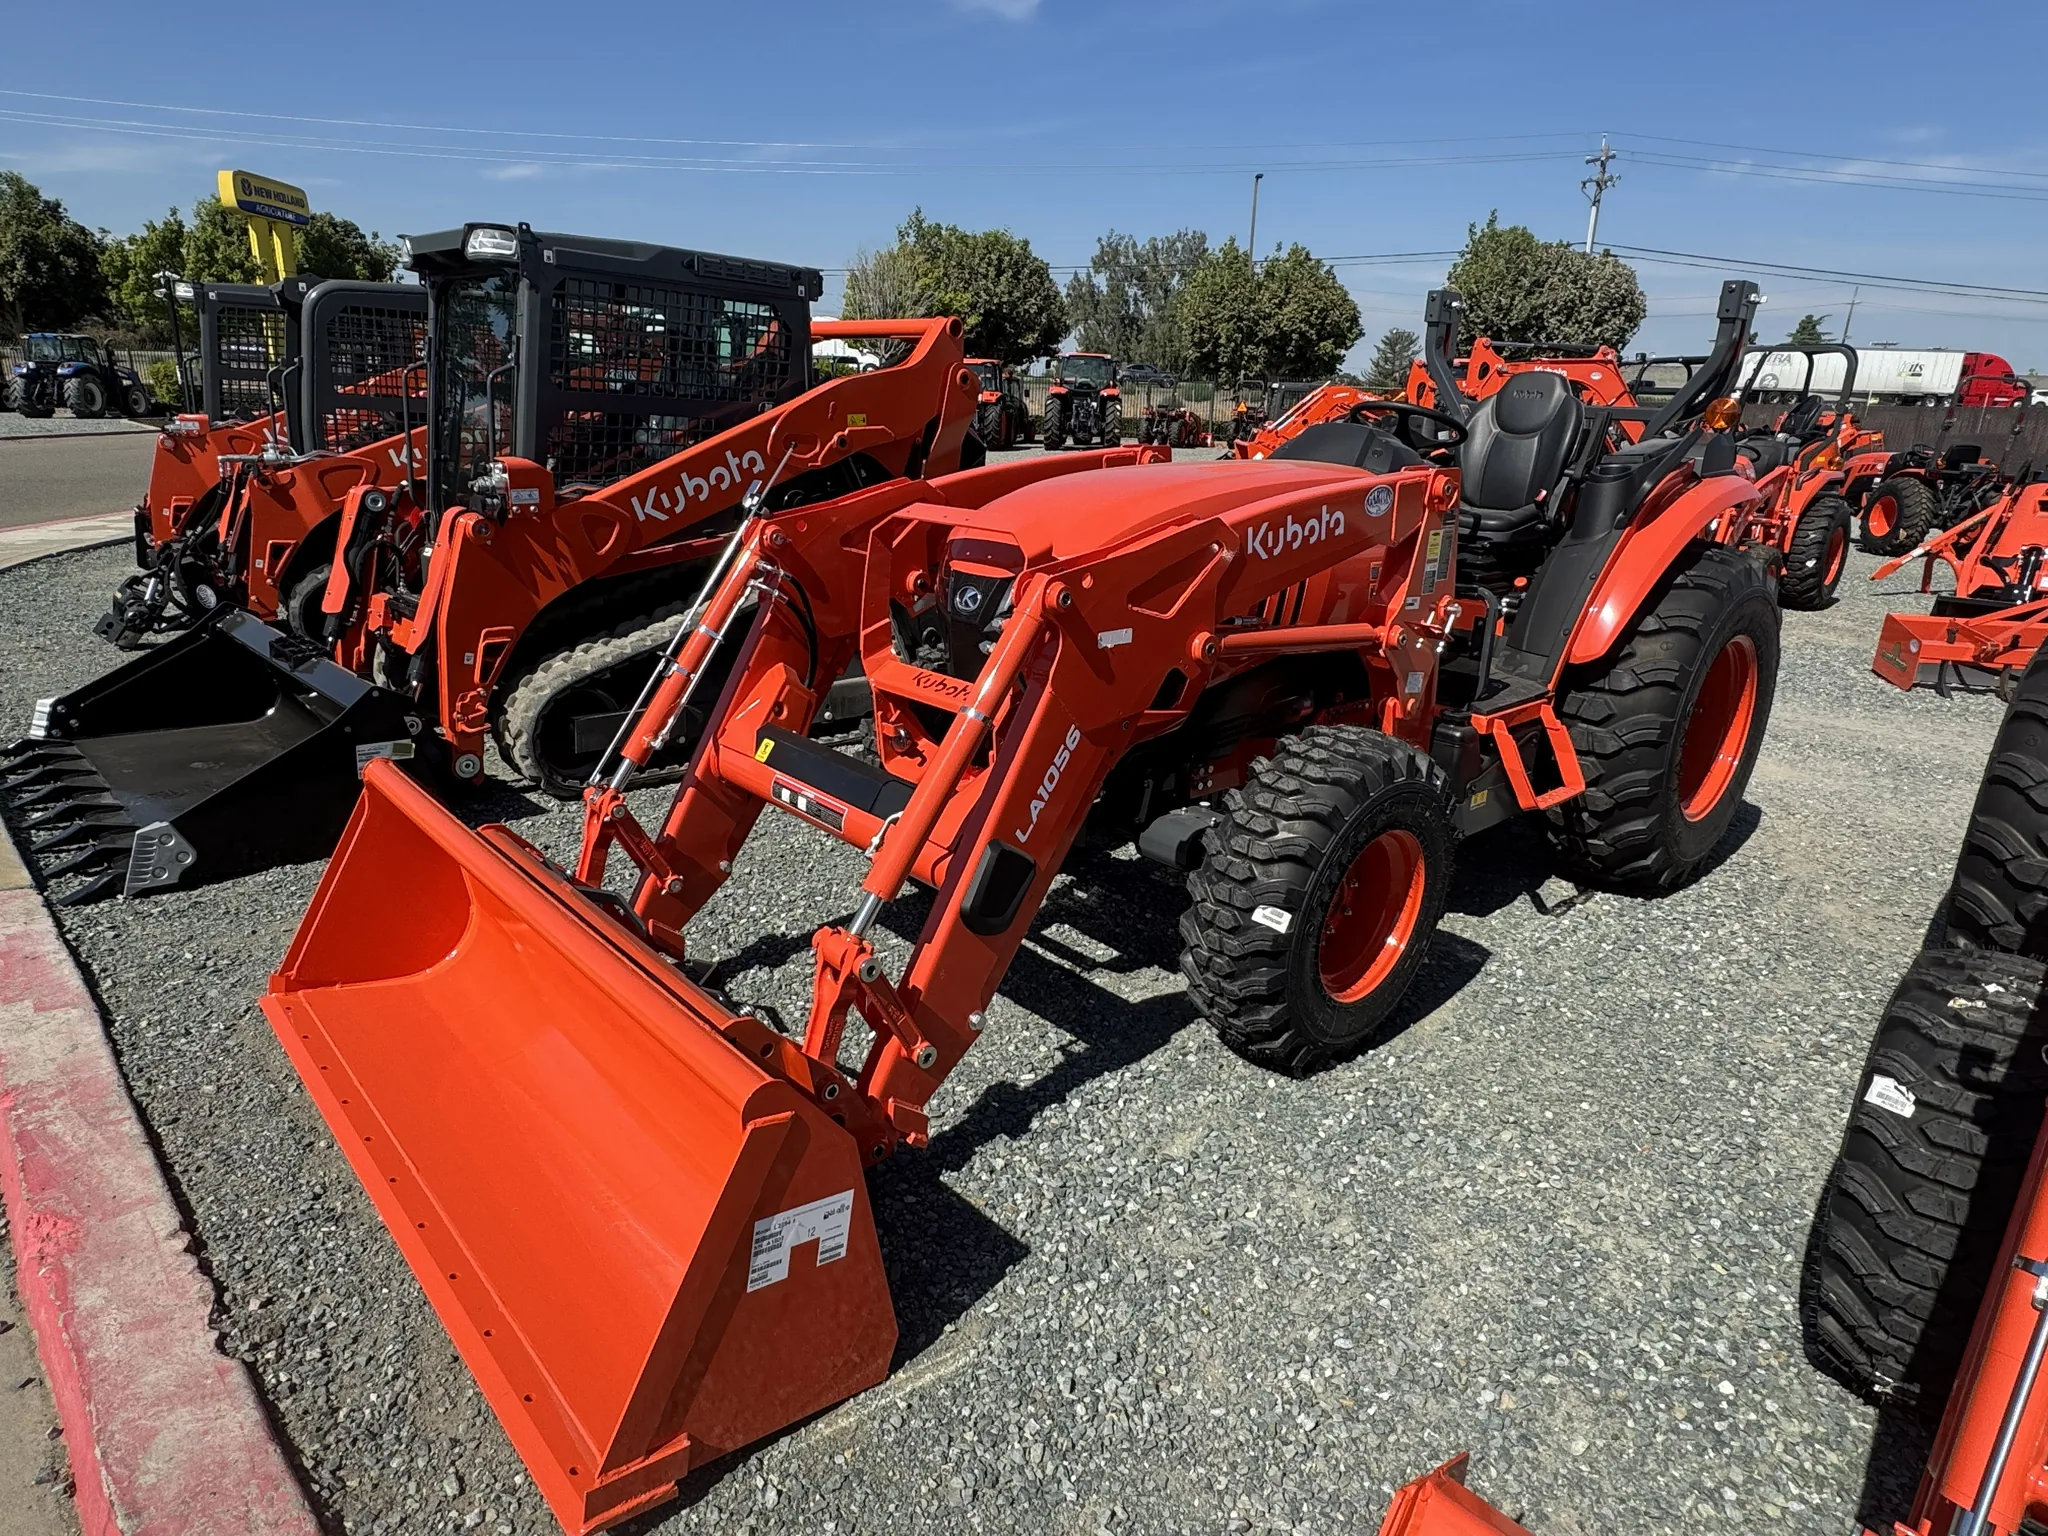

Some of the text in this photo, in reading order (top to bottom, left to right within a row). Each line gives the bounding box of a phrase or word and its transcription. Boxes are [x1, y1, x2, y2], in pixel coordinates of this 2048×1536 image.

[253, 185, 305, 208] NEW HOLLAND
[631, 450, 766, 521] Kubota
[1247, 504, 1345, 560] Kubota
[1015, 724, 1081, 844] LA1056
